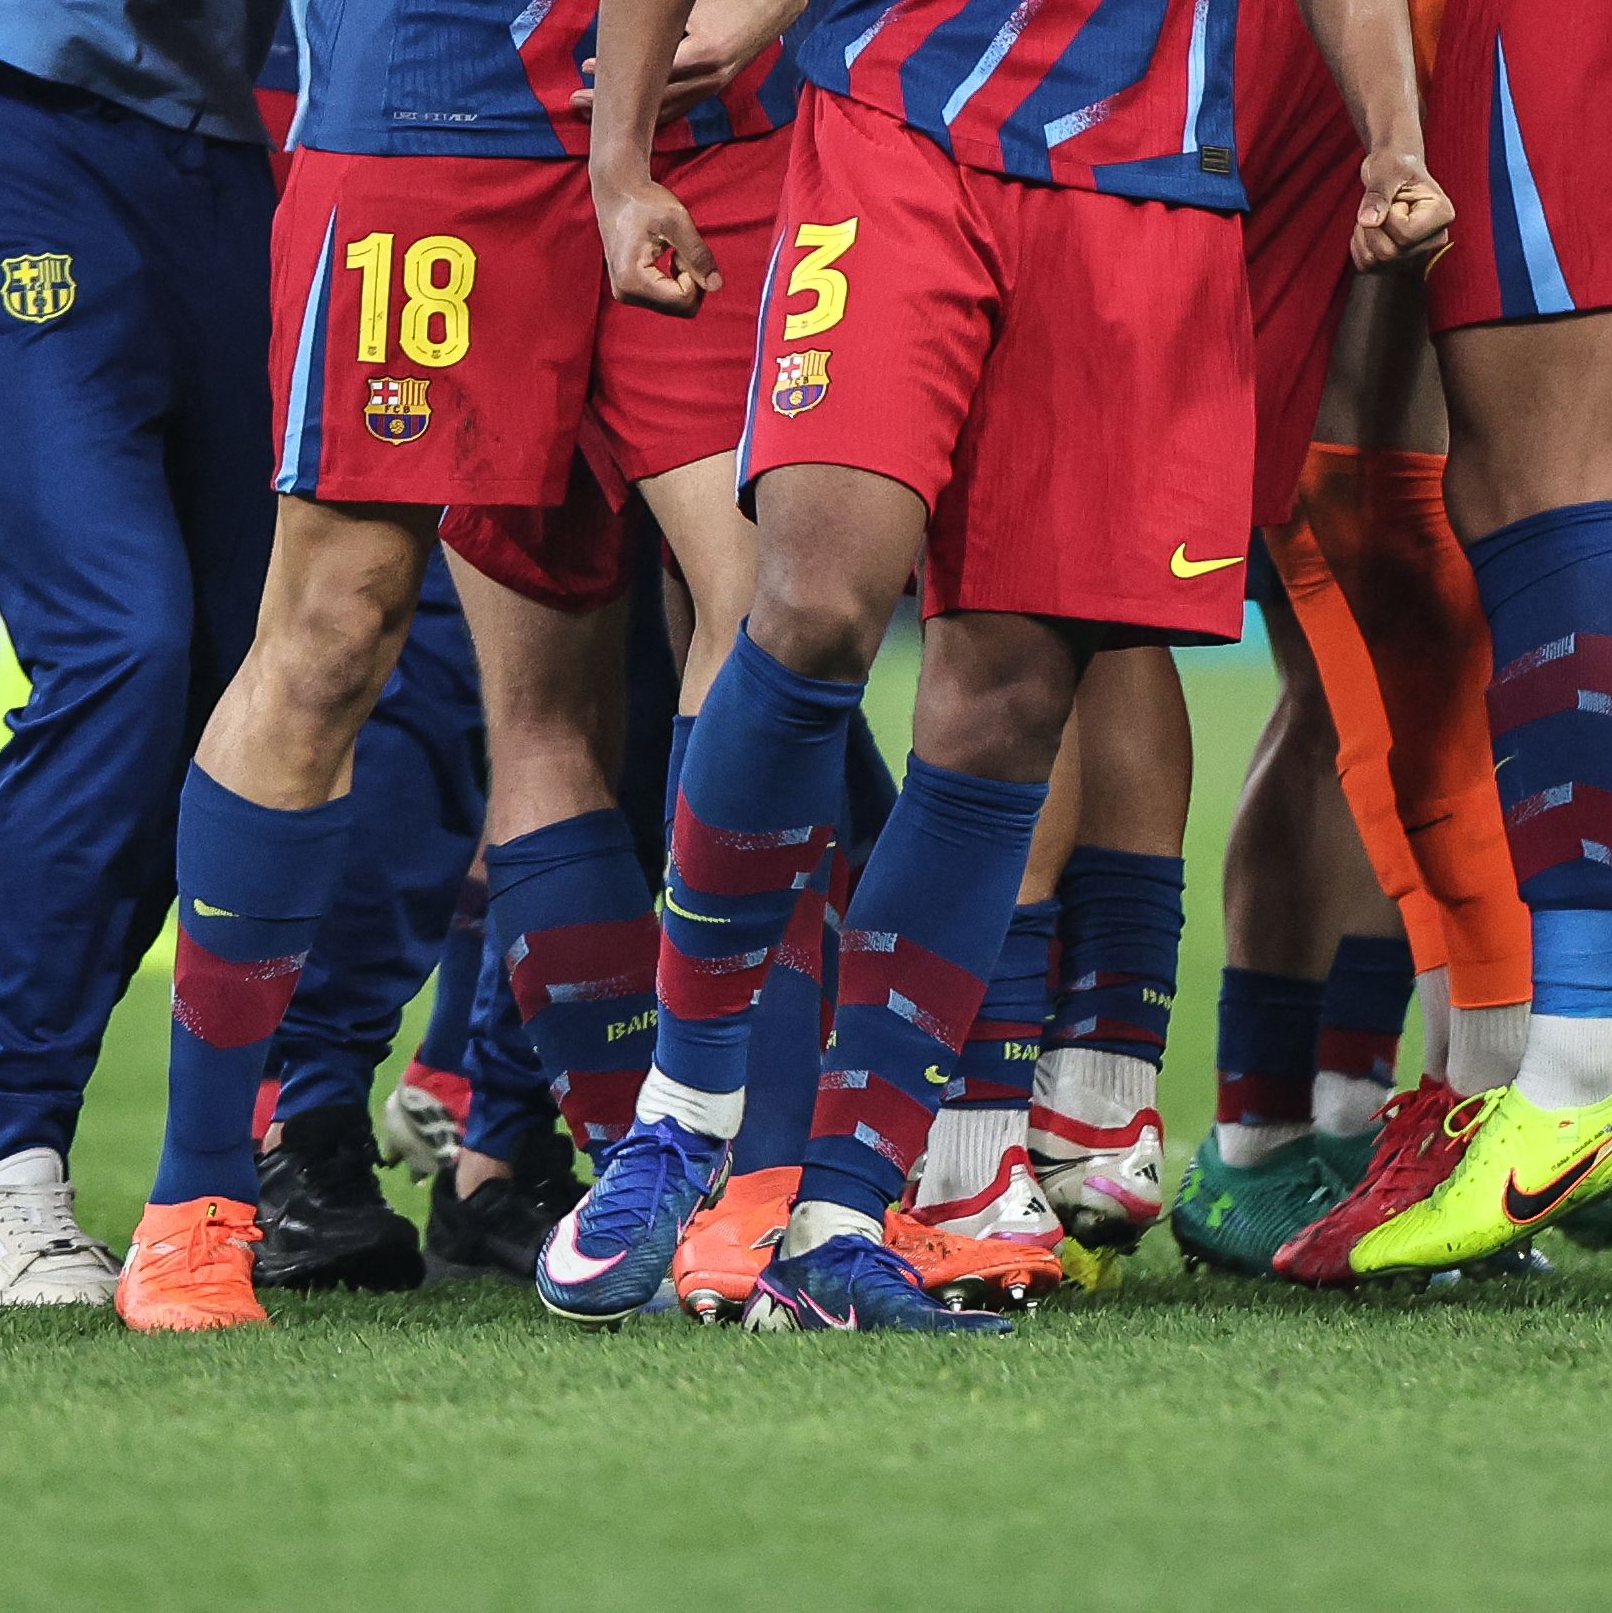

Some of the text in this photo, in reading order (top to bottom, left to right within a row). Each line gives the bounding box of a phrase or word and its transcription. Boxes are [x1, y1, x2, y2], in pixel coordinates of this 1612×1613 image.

[346, 232, 477, 368] 18
[783, 216, 859, 341] 3
[385, 404, 411, 414] FCB
[608, 1009, 658, 1042] BAR
